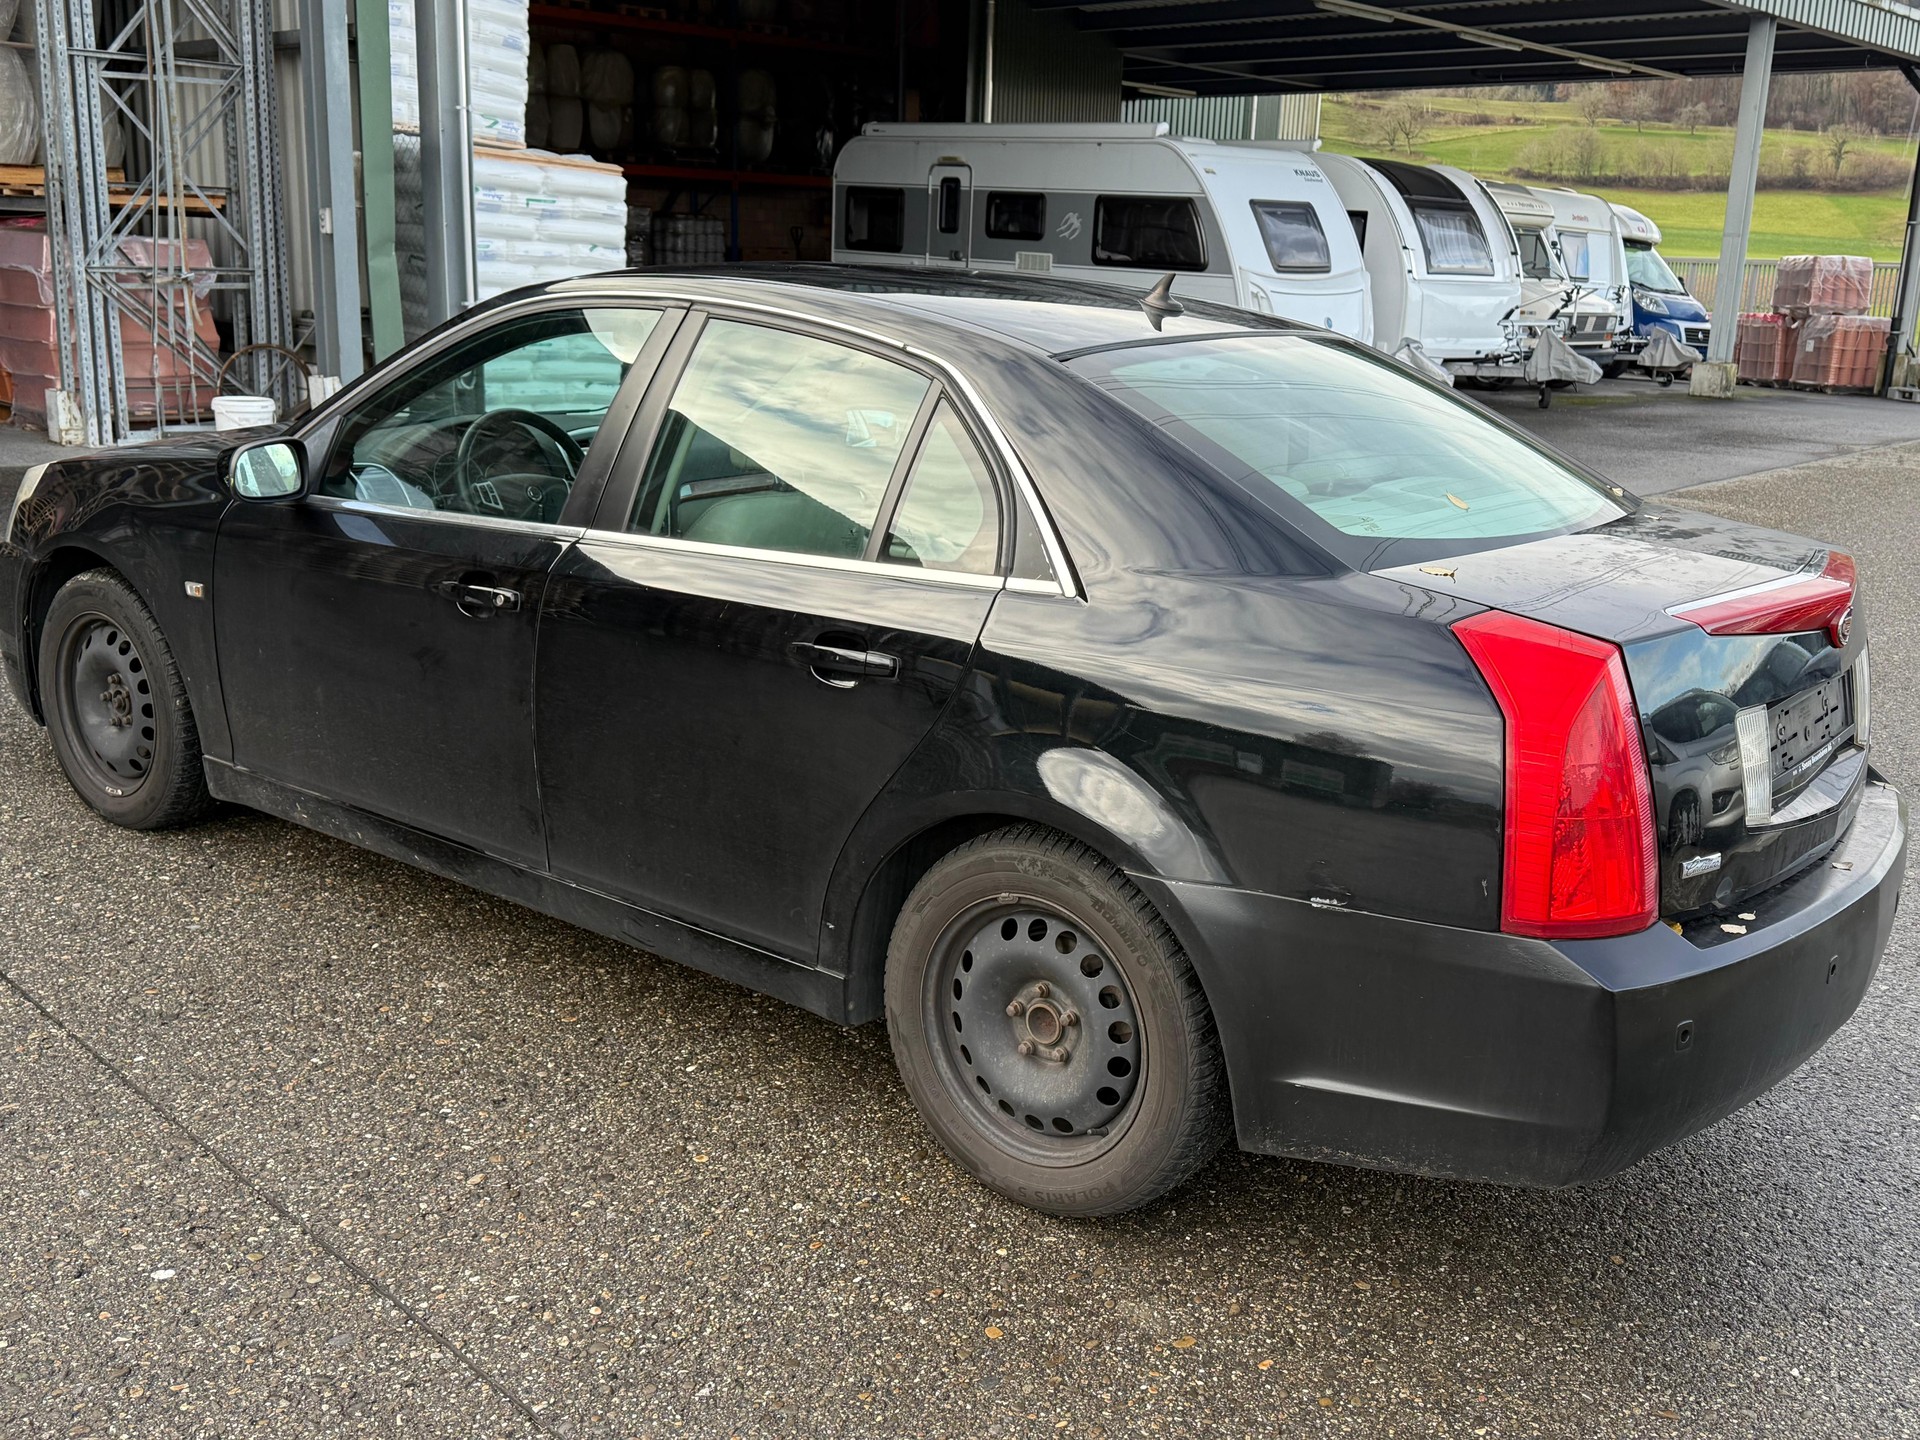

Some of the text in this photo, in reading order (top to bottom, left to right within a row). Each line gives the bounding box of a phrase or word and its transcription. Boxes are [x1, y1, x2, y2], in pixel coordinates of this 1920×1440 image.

[1293, 169, 1320, 177] KNAUS
[1017, 1181, 1115, 1204] POLARIS 5
